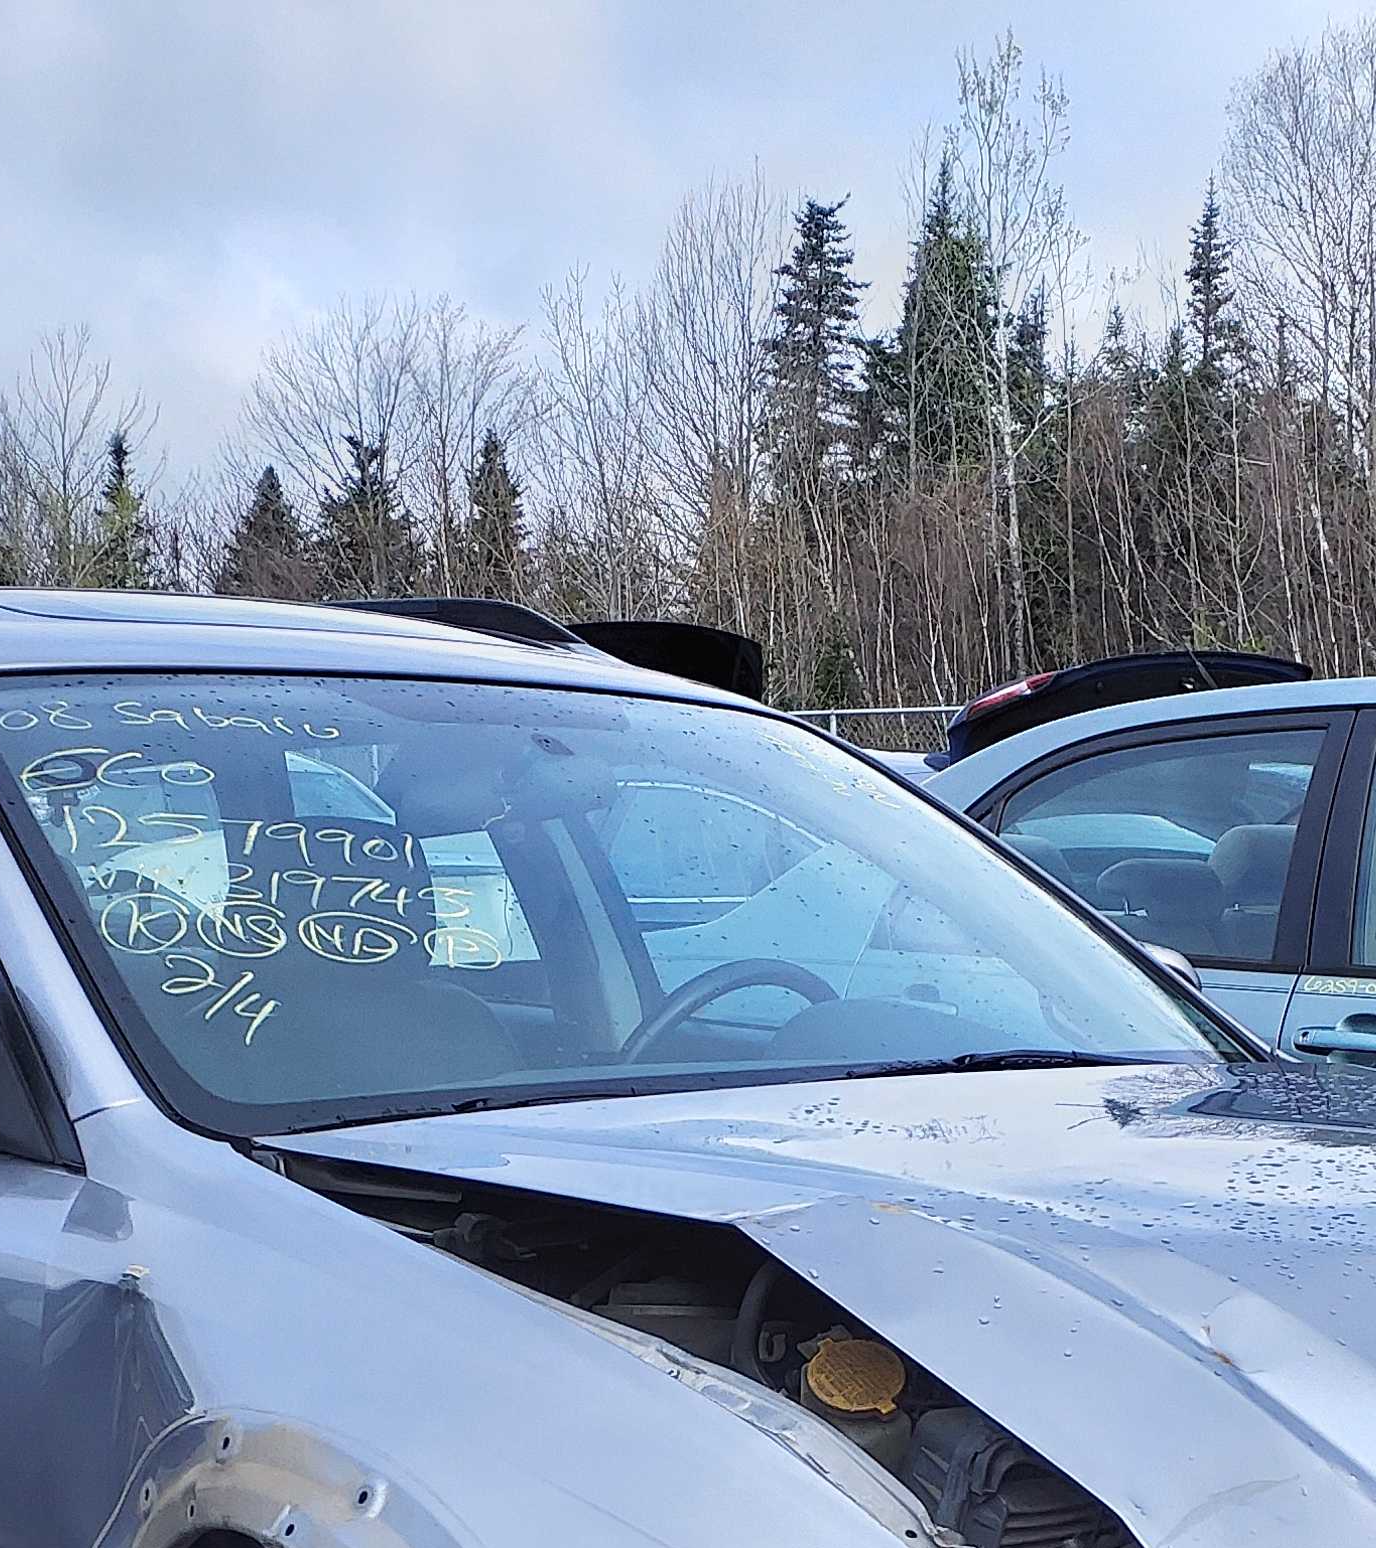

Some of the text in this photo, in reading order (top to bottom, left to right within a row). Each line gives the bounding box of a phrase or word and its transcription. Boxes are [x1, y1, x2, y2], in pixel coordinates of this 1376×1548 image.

[0, 701, 93, 730] 08
[63, 804, 414, 870] 12579901
[161, 955, 282, 1046] 2/4
